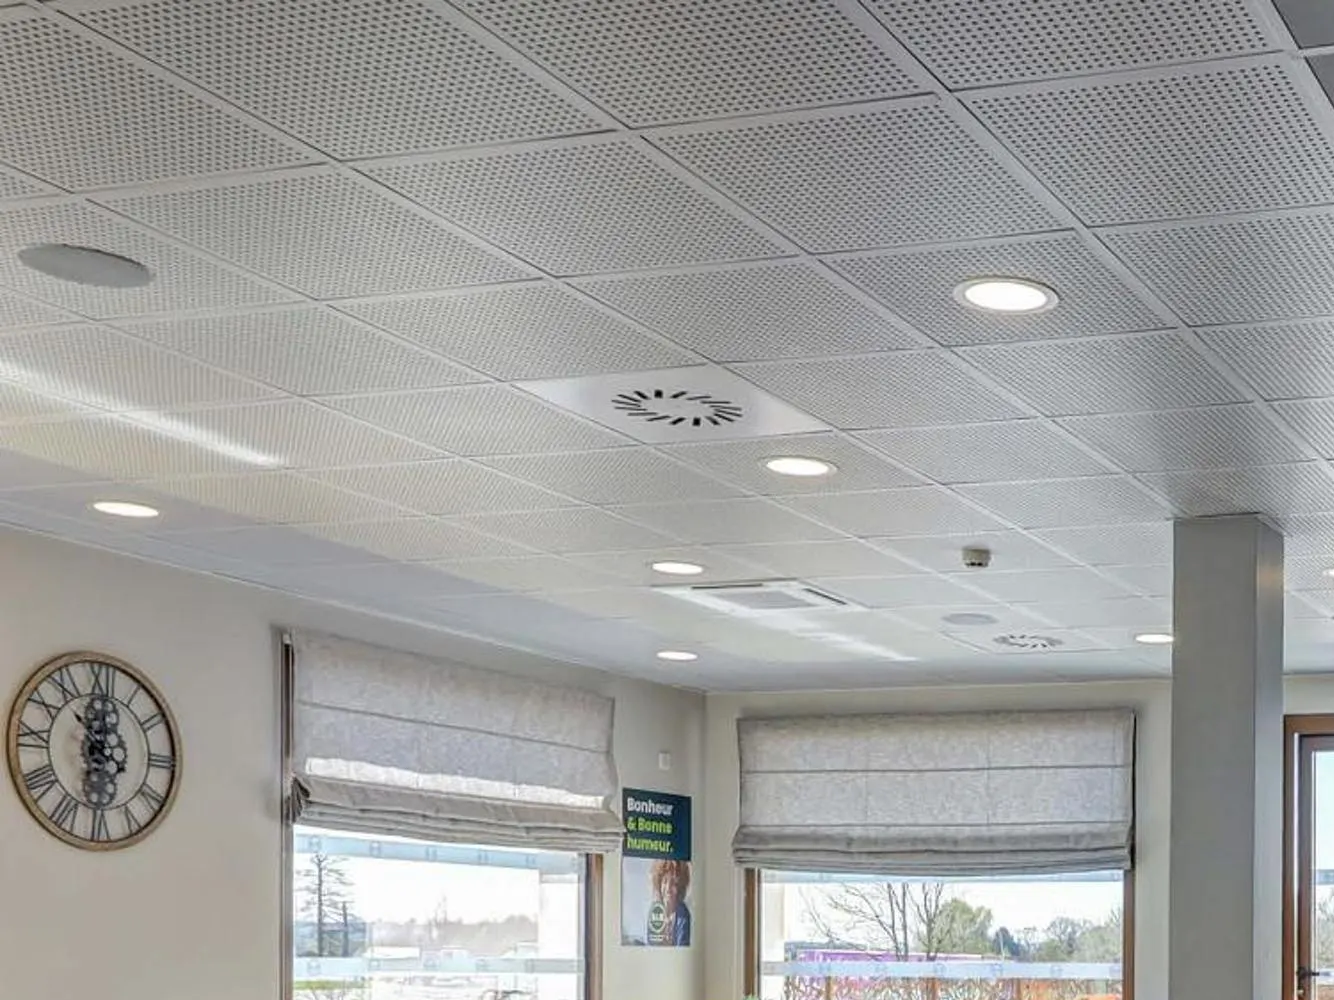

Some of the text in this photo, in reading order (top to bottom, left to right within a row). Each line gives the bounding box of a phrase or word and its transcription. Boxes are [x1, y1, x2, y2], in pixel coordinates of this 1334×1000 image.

[627, 796, 673, 816] Bonheur
[627, 816, 673, 835] & Bonne
[627, 833, 674, 853] humeur.
